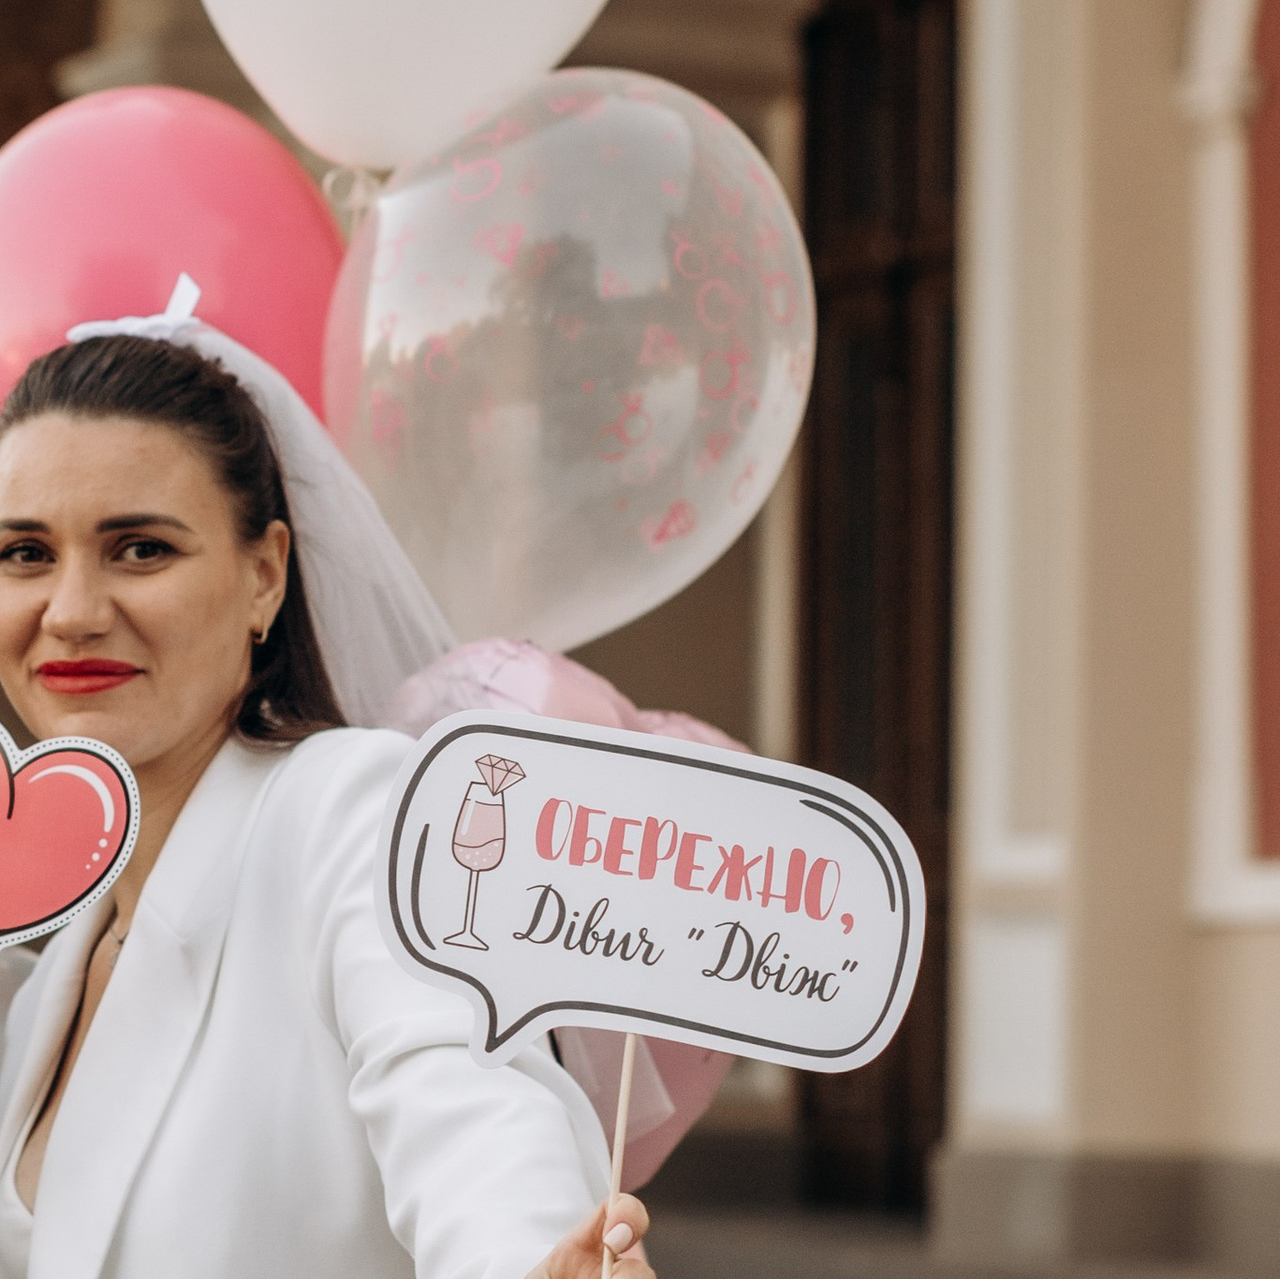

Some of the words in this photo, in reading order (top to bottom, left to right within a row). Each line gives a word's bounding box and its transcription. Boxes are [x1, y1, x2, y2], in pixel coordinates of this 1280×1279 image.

[534, 797, 855, 935] ОБЕРЕЖНО,
[512, 883, 665, 967] Дівич
[687, 921, 859, 1003] "Двіж"
